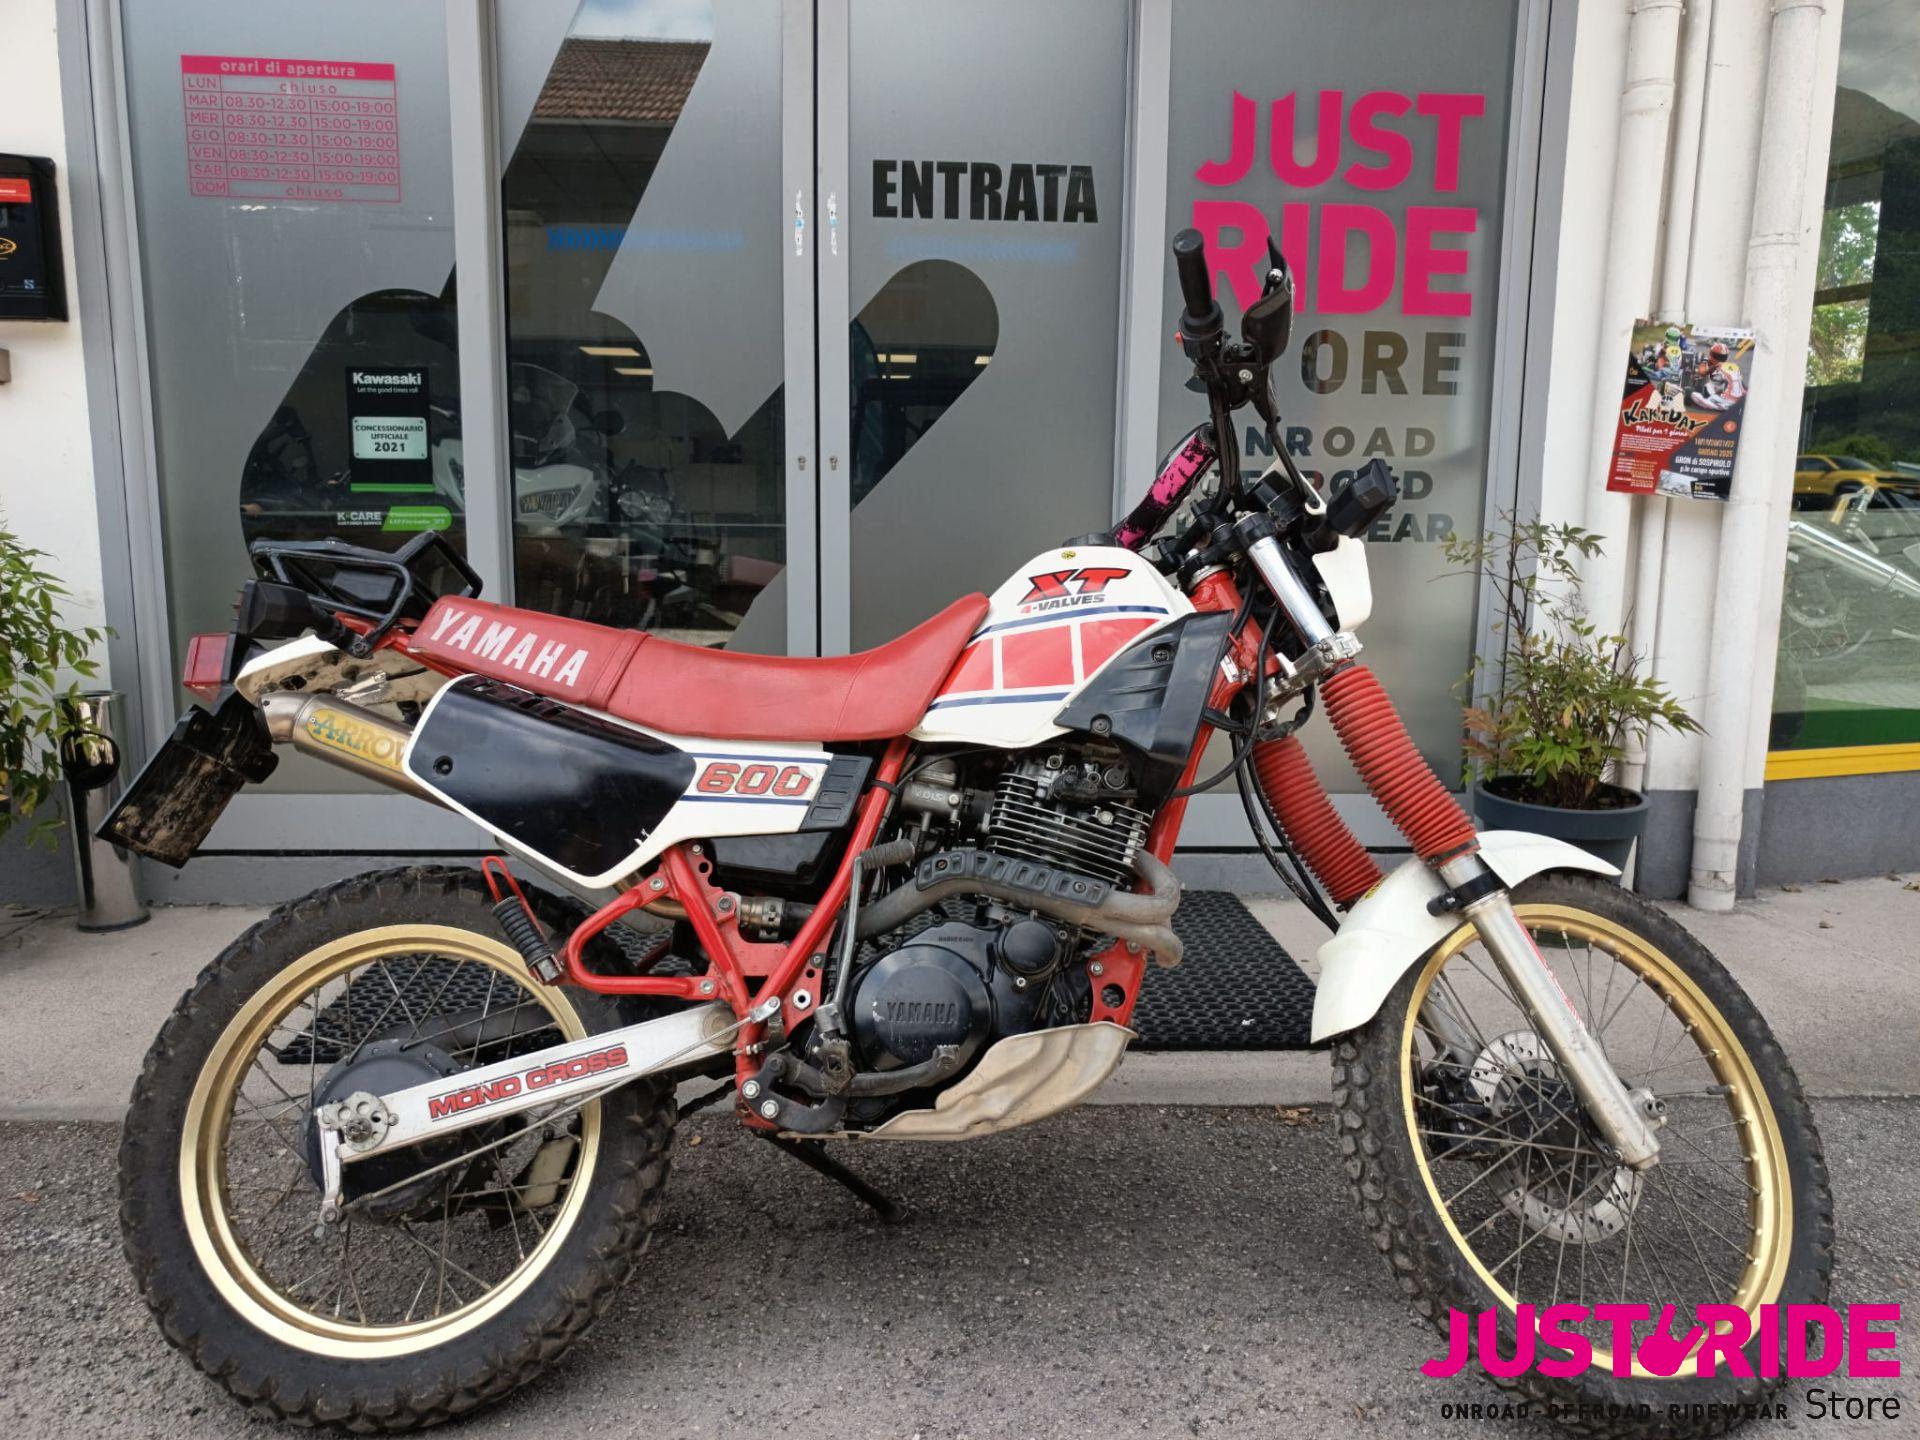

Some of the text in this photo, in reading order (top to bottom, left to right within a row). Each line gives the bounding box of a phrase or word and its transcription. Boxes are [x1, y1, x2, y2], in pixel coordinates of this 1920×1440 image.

[220, 60, 356, 77] orari di apertura
[187, 77, 338, 94] LUN chiuso
[188, 94, 219, 107] MAR
[190, 111, 219, 123] MER
[191, 129, 220, 141] GIO
[1194, 88, 1486, 192] JUST
[192, 146, 222, 158] VEN
[194, 164, 223, 176] SAB
[195, 182, 343, 198] DOM chiuso
[872, 159, 1099, 224] ENTRATA
[1192, 199, 1478, 317] RIDE
[352, 372, 422, 386] Kawasaki
[355, 424, 424, 432] CONCESSIONARIO
[374, 442, 406, 452] 2021
[1245, 426, 1436, 457] NROAD
[1017, 567, 1132, 606] XT
[1020, 594, 1106, 614] 4-VALVES
[430, 608, 588, 687] YAMAHA
[696, 762, 814, 796] 600
[887, 1001, 960, 1025] YAMAHA
[428, 1046, 629, 1119] MONO CROSS
